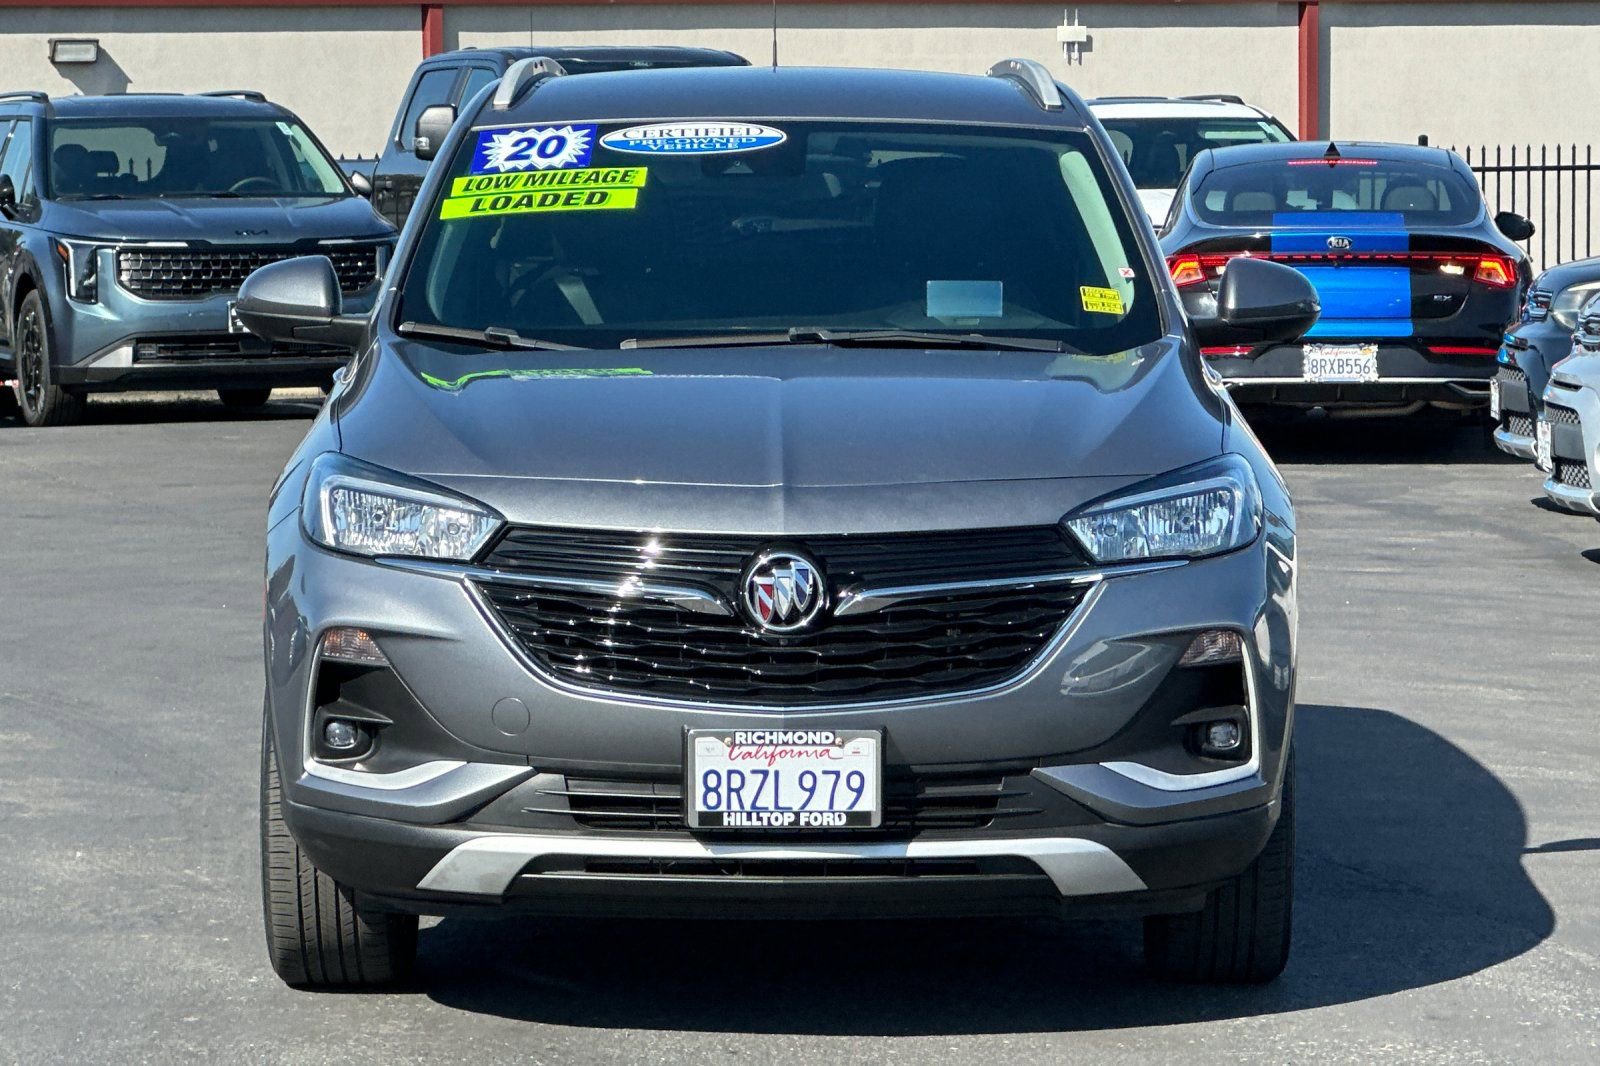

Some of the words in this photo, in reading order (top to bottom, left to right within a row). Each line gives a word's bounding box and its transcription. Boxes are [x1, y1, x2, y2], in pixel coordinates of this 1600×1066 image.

[622, 126, 764, 139] CERTIFIED
[503, 134, 569, 162] 20
[628, 136, 757, 147] PRE-OWNED
[647, 142, 740, 151] VEHICLE
[462, 174, 519, 193] LOW
[521, 169, 638, 188] MILEAGE
[469, 190, 611, 213] LOADED
[1310, 358, 1371, 375] 8RXB556
[734, 731, 835, 745] RICHMOND
[728, 744, 844, 767] California
[702, 768, 866, 811] 8RZL979
[722, 811, 795, 826] HILLTOP
[799, 811, 847, 826] FORD
